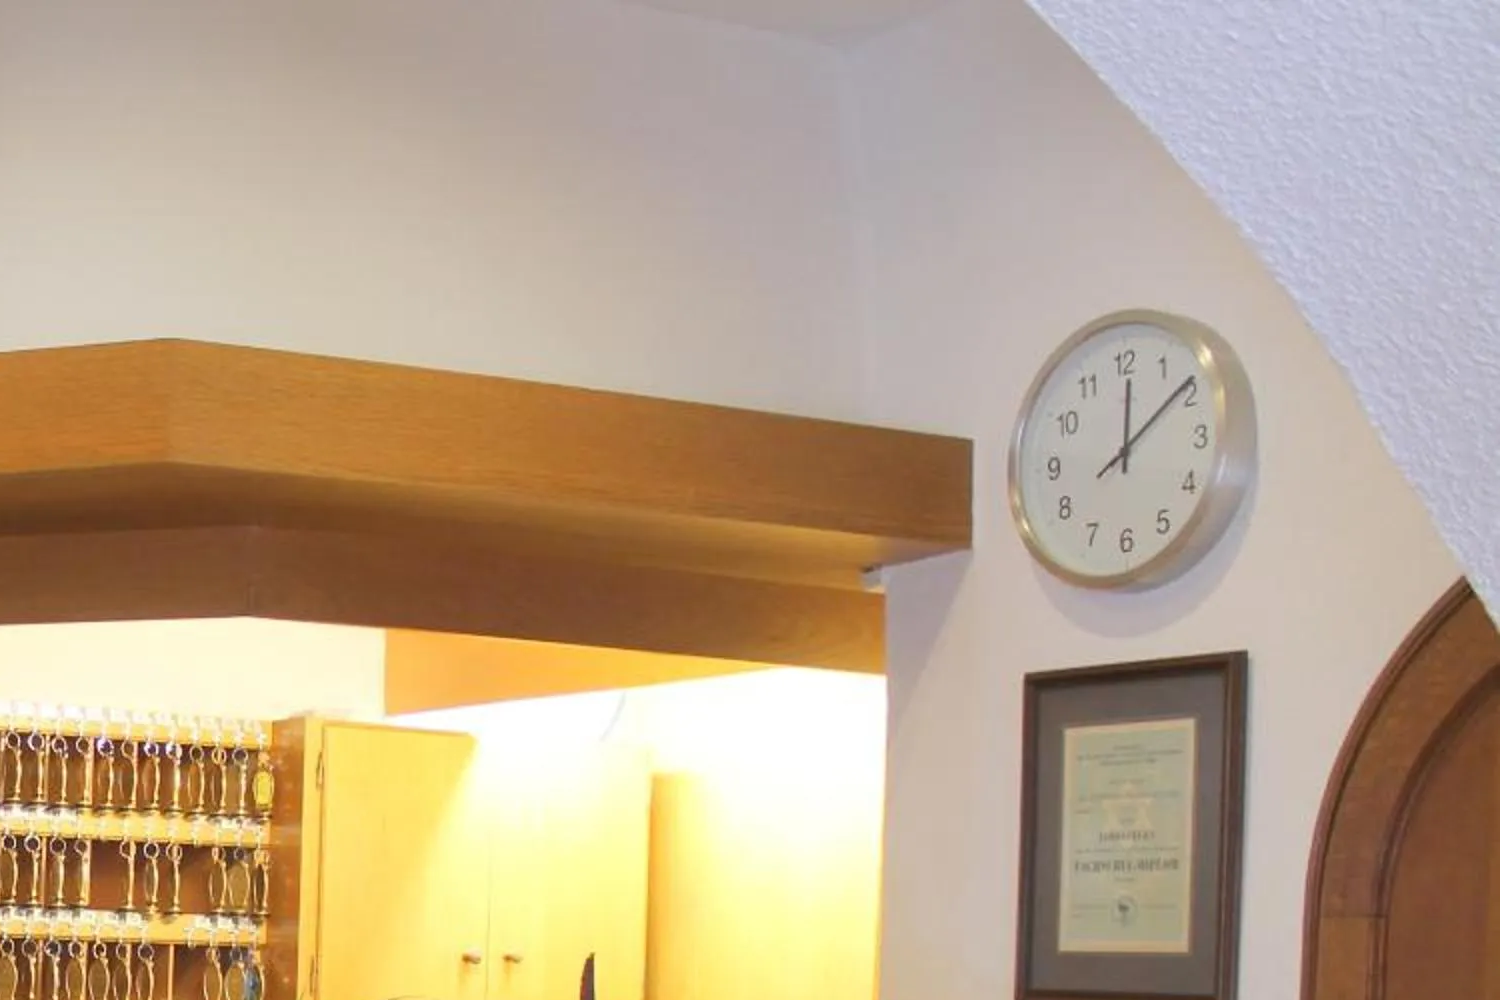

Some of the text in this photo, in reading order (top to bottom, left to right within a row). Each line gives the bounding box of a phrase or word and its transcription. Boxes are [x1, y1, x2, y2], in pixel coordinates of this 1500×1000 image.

[1113, 350, 1135, 376] 12
[1157, 356, 1167, 380] 1
[1077, 374, 1097, 400] 11
[1183, 380, 1197, 407] 2
[1057, 411, 1079, 438] 10
[1193, 424, 1208, 449] 3
[1047, 456, 1061, 480] 9
[1181, 469, 1197, 494] 4
[1059, 495, 1072, 520] 8
[1085, 522, 1099, 547] 7
[1156, 509, 1171, 535] 5
[1119, 528, 1134, 553] 6
